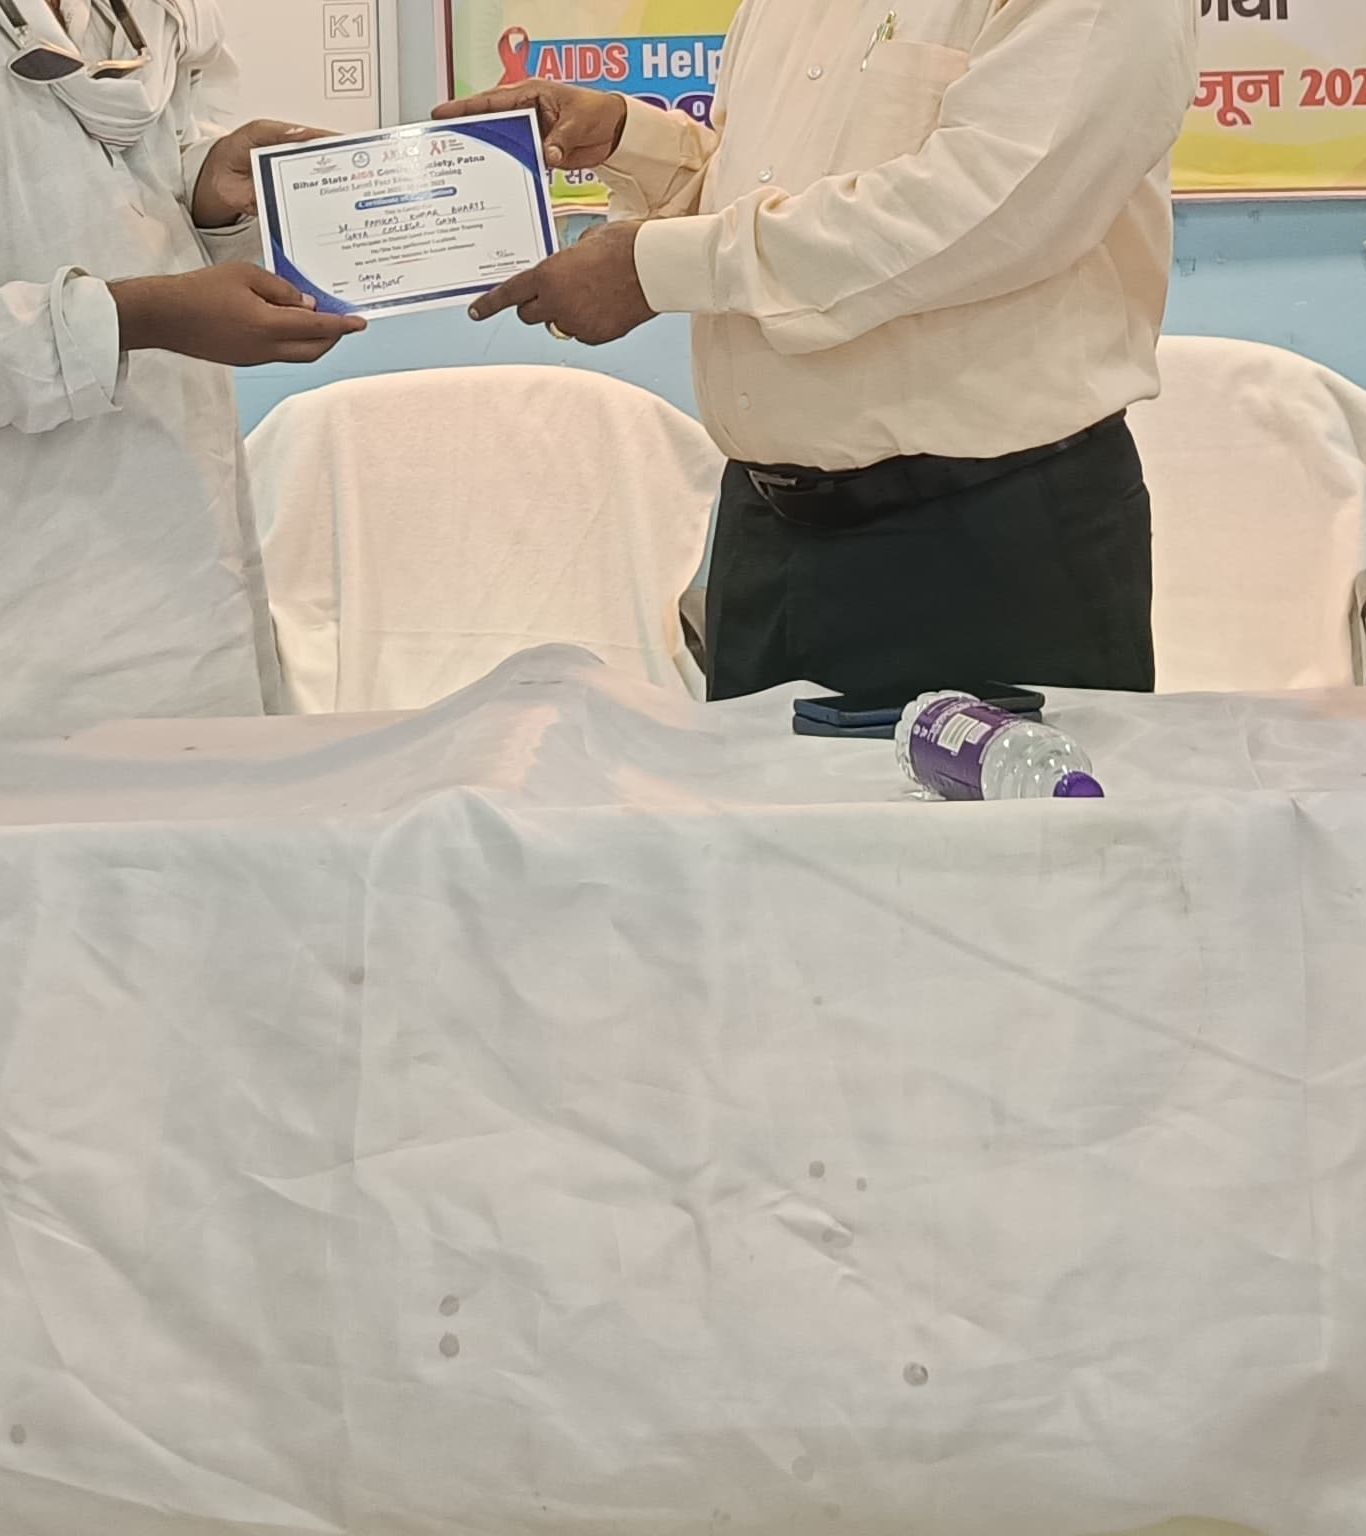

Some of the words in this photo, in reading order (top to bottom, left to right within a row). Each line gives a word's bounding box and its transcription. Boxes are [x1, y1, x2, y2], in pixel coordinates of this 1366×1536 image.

[537, 44, 629, 81] AIDS
[642, 42, 723, 85] Help
[1193, 70, 1284, 127] जून
[292, 180, 319, 190] Bihar
[321, 175, 348, 185] State
[457, 155, 485, 164] Patna
